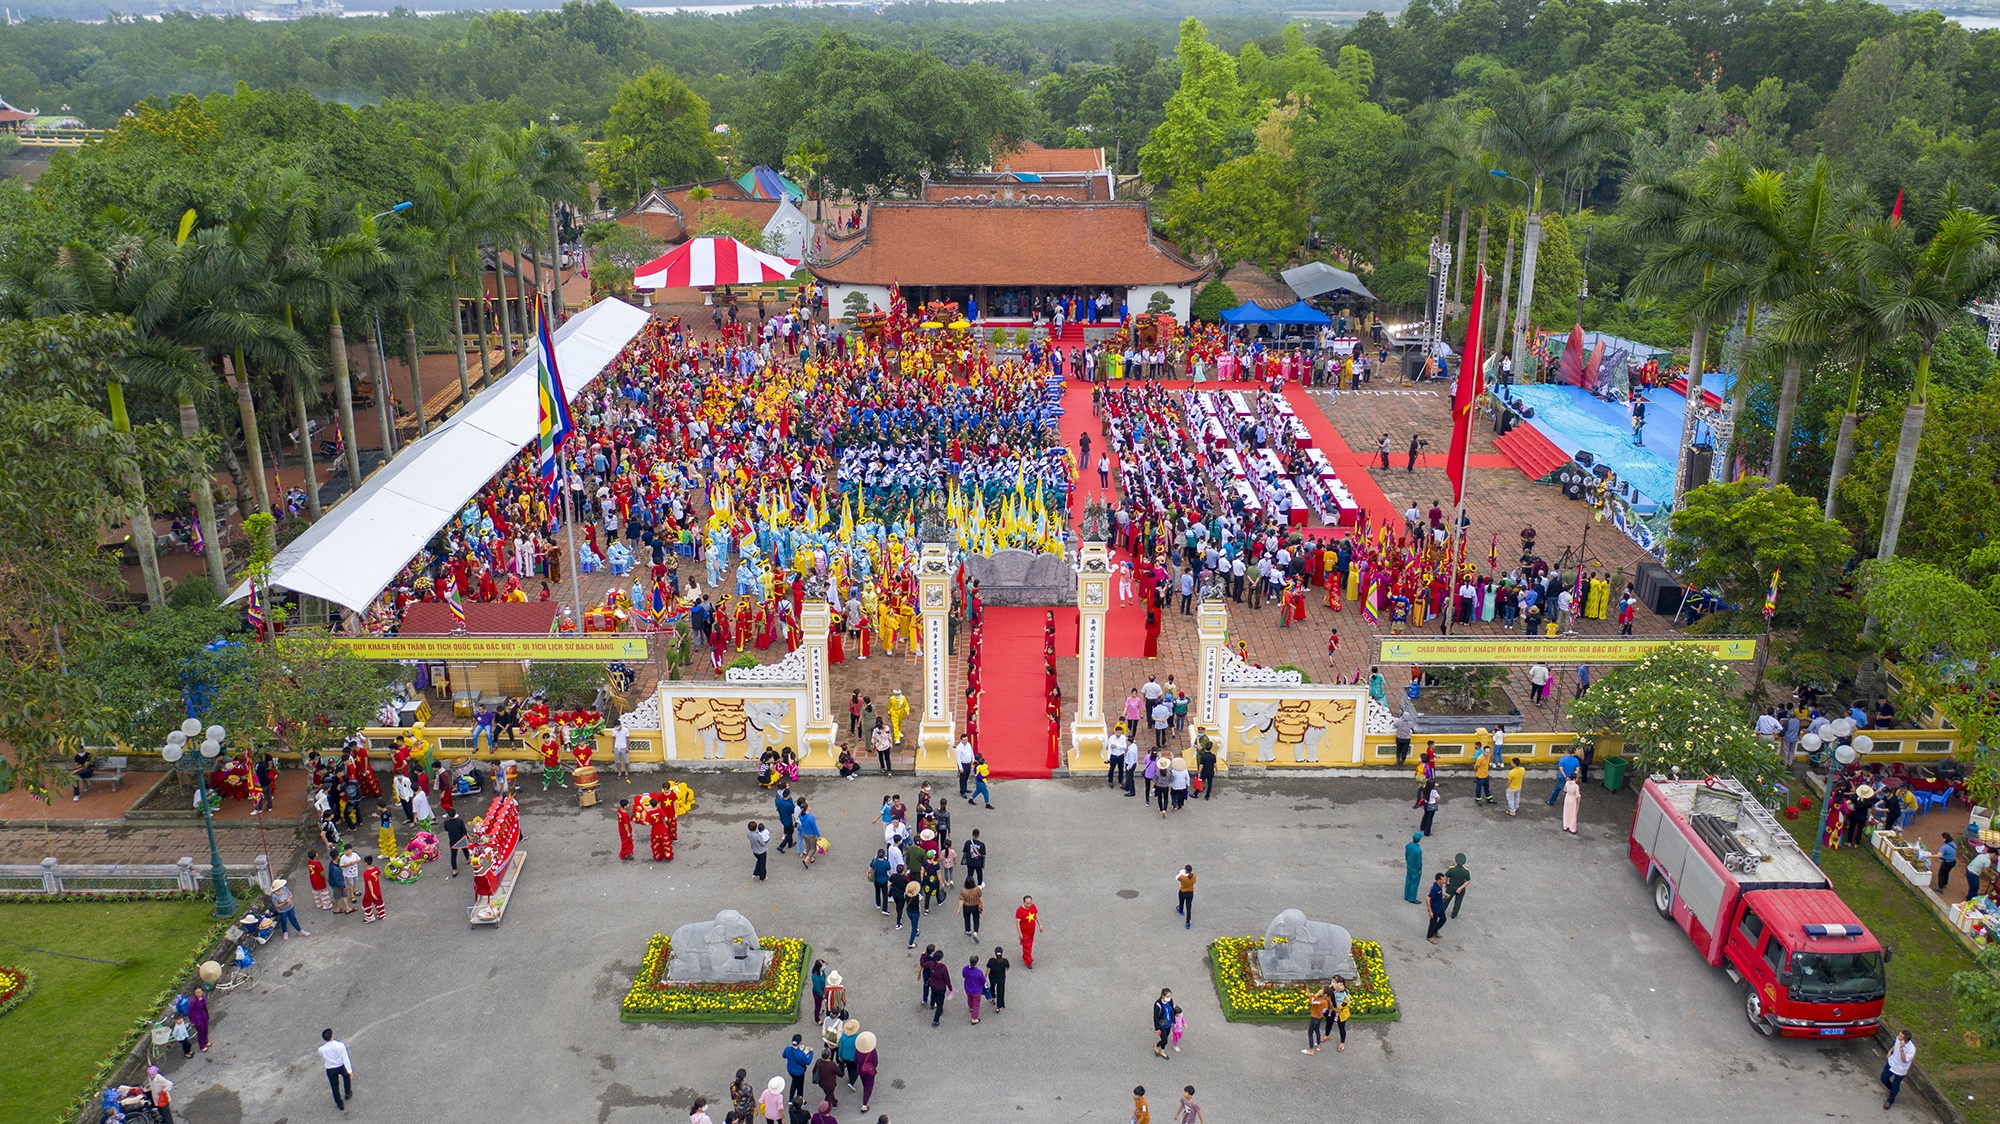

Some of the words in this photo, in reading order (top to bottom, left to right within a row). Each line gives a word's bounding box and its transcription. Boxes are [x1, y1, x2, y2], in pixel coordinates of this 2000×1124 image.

[353, 642, 365, 651] QUÝ
[368, 642, 390, 651] KHÁCH
[392, 641, 406, 651] ĐẾN
[437, 642, 451, 651] TÍCH
[453, 641, 470, 651] QUỐC
[502, 643, 515, 652] BIỆT
[532, 642, 546, 651] TÍCH
[548, 643, 562, 652] LỊCH
[576, 643, 593, 652] BẠCH
[1459, 644, 1471, 653] QUÝ
[1473, 643, 1496, 653] KHÁCH
[1498, 643, 1511, 653] ĐẾN
[1543, 644, 1557, 653] TÍCH
[1559, 643, 1576, 653] QUỐC
[1607, 645, 1622, 653] BIỆT
[1638, 644, 1652, 652] TÍCH
